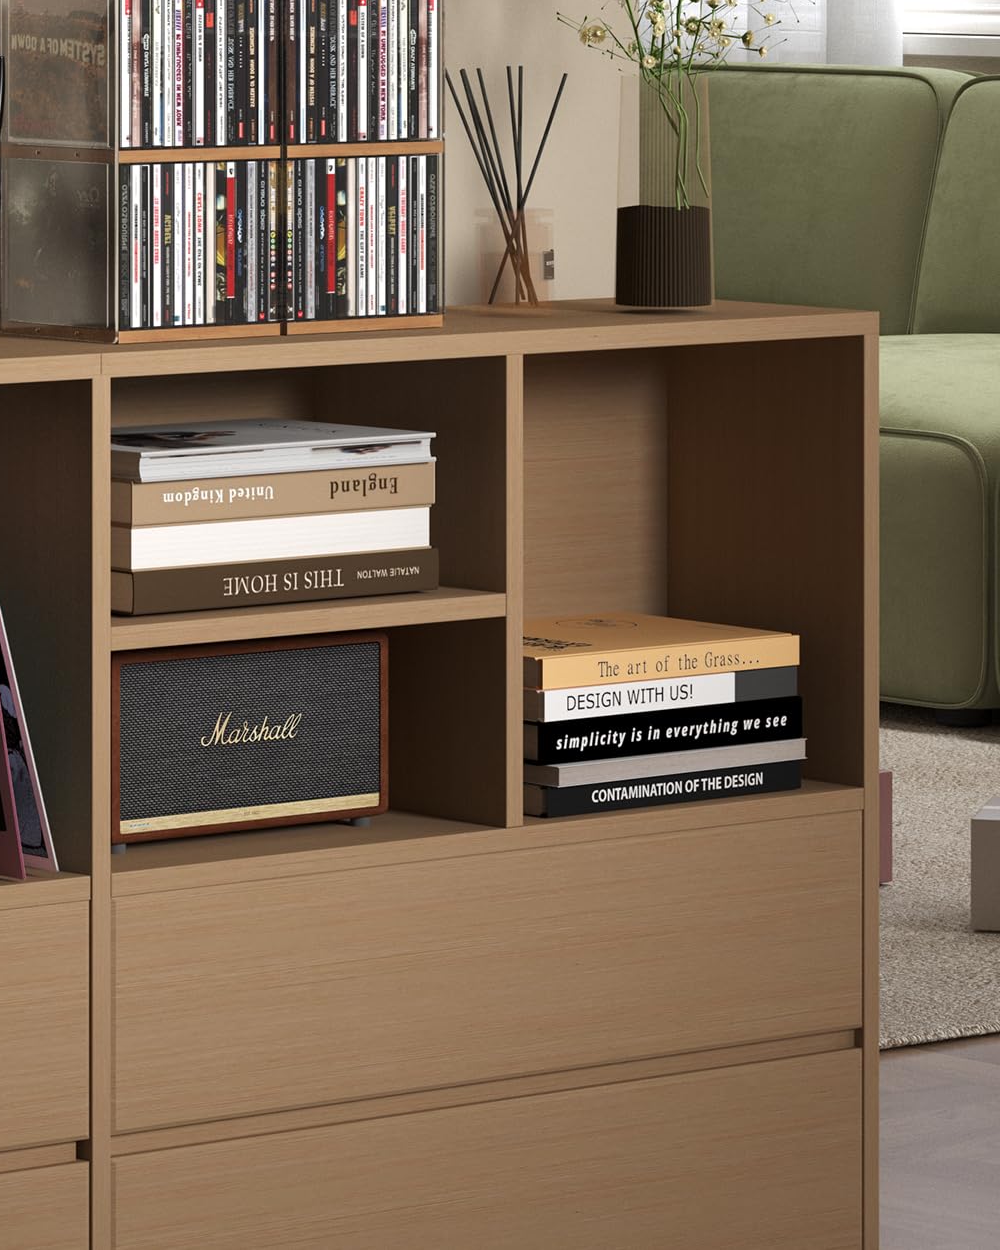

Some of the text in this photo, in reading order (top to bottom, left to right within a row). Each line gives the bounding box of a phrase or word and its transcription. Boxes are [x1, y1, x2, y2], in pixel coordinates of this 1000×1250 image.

[163, 485, 274, 506] United Kingdom
[330, 473, 398, 499] England
[223, 568, 344, 596] THIS IS HOME
[356, 566, 420, 580] NATALIE WALTON
[598, 660, 620, 678] The
[627, 659, 647, 676] art
[656, 655, 670, 673] of
[678, 654, 698, 671] the
[566, 684, 694, 711] DESIGN WITH US!
[201, 712, 303, 747] Marshall
[556, 714, 788, 752] simplicity is in everything we see
[591, 772, 764, 803] CONTAMINATION OF THE DESIGN
